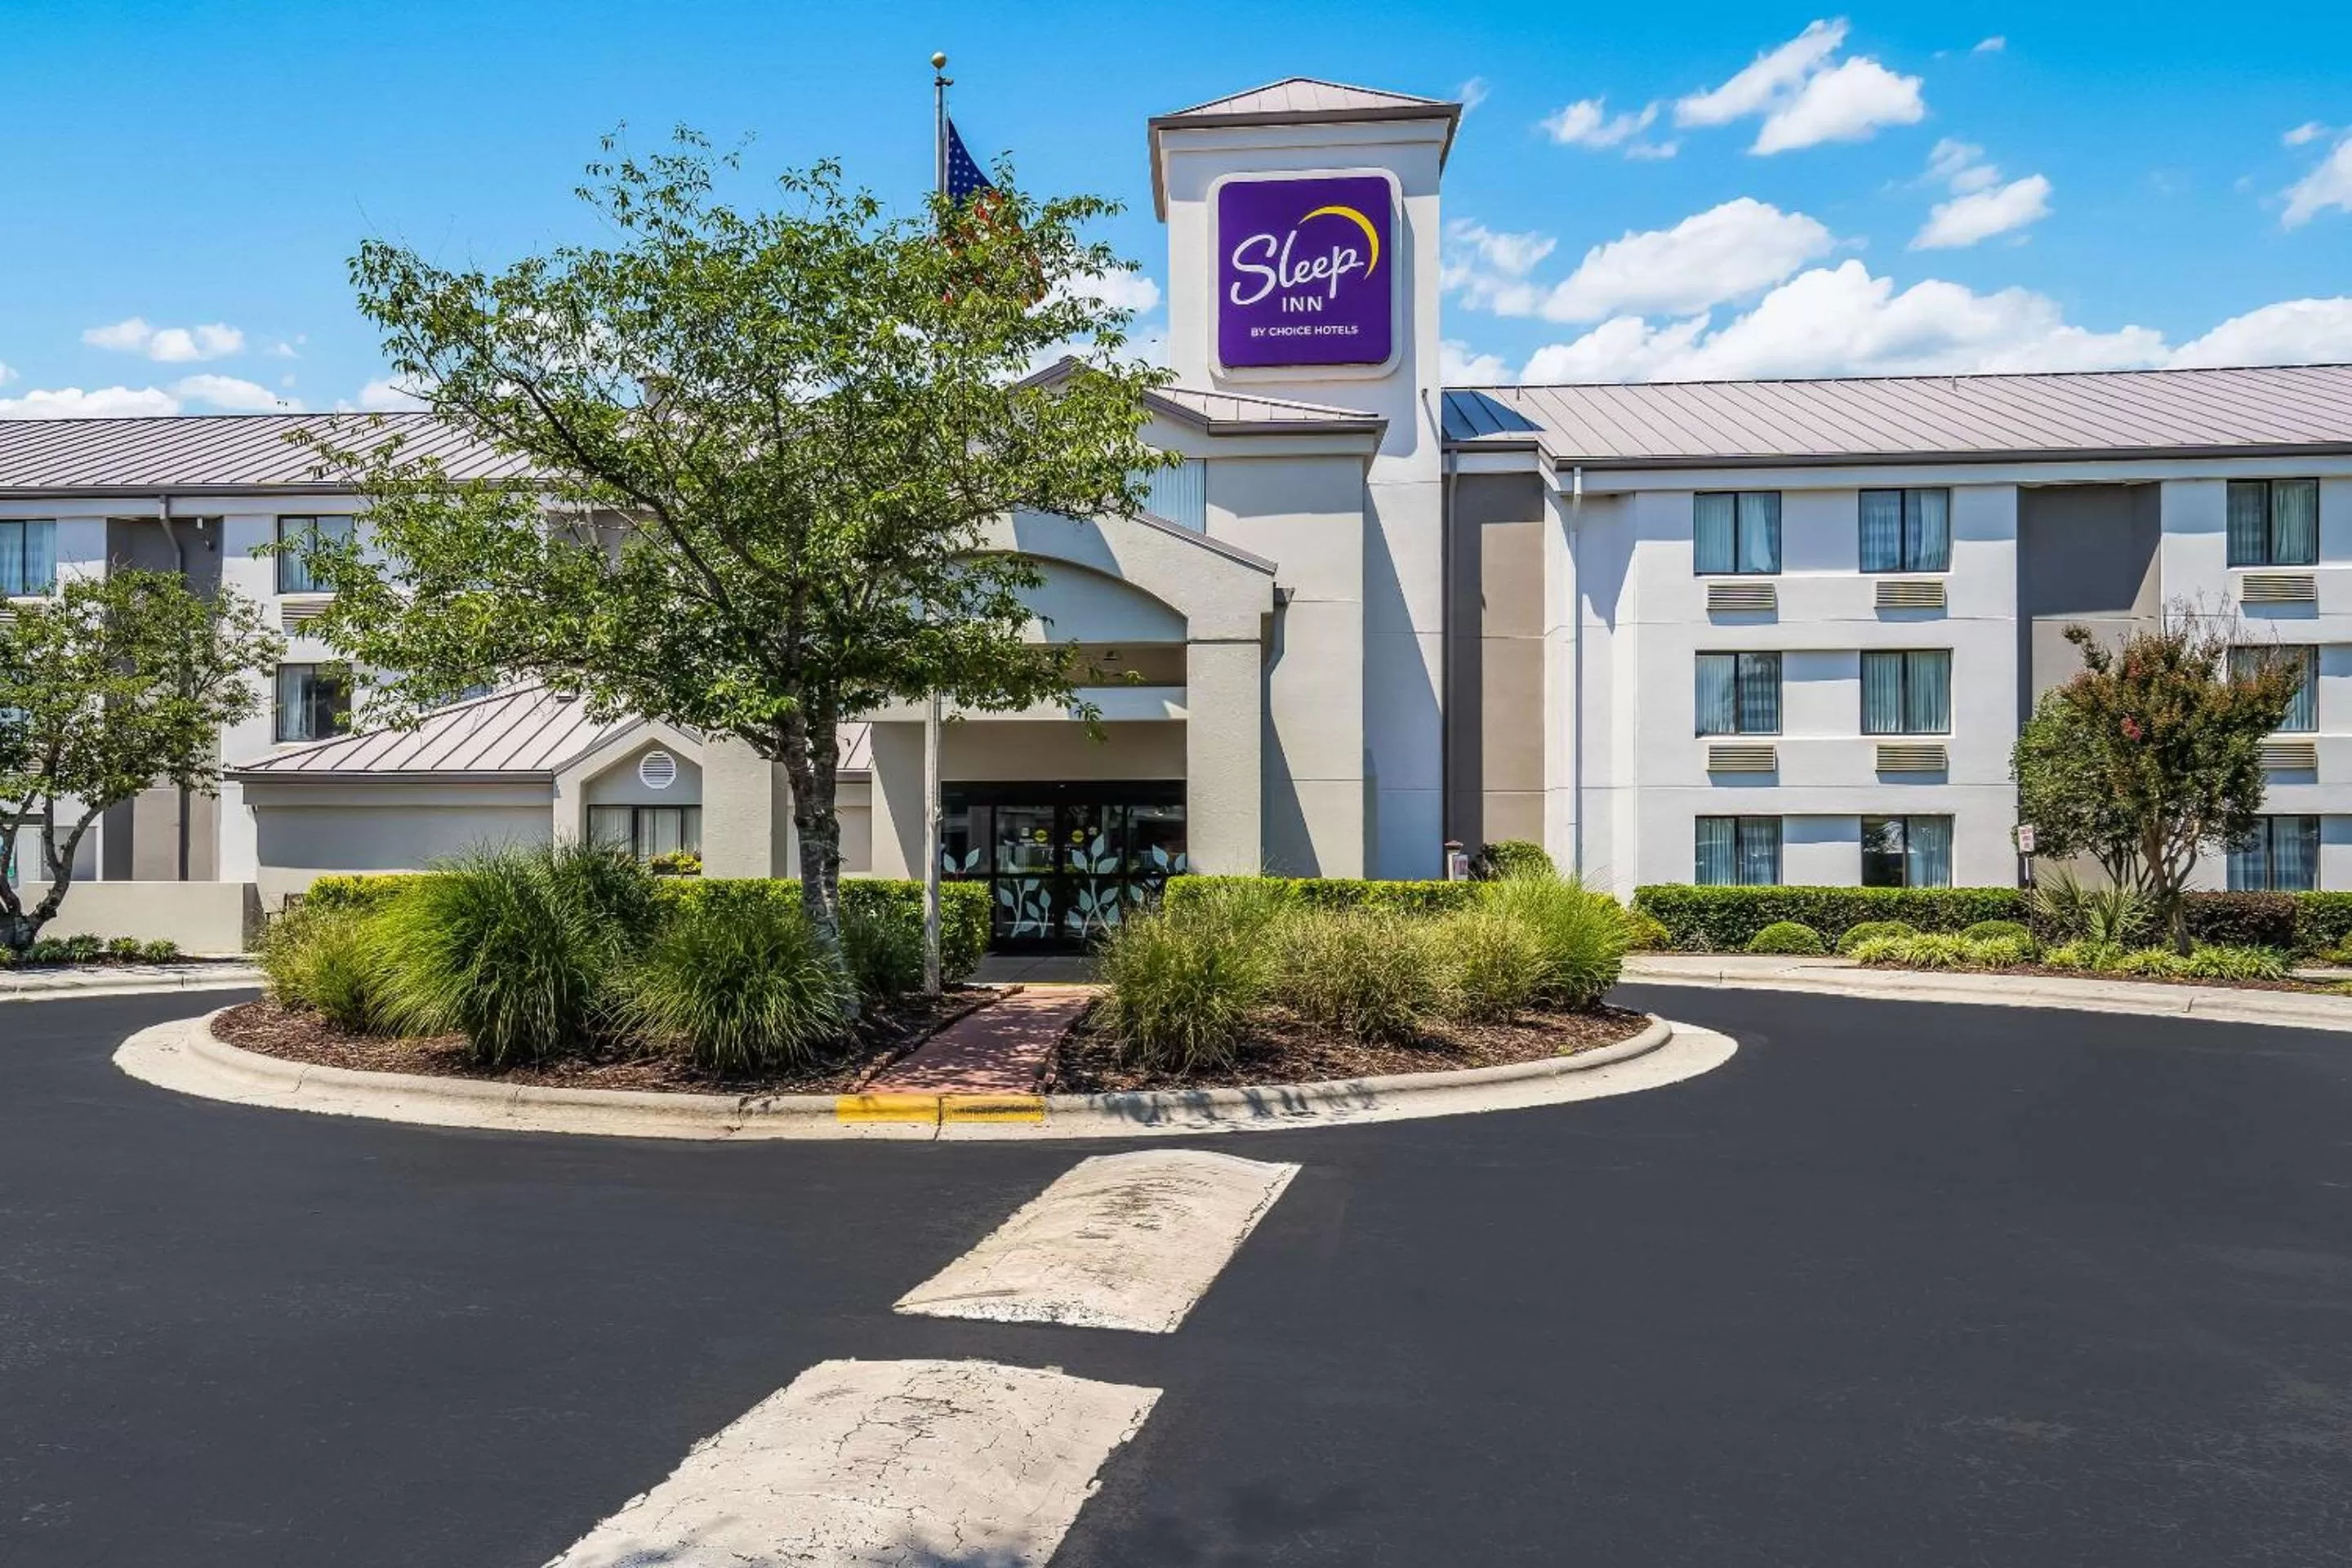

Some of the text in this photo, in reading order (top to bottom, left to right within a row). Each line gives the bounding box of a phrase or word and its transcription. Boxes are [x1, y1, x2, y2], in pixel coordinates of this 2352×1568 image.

[1231, 230, 1364, 305] Sleep
[1282, 296, 1323, 313] INN
[1251, 325, 1358, 337] BY CHOICE HOTELS
